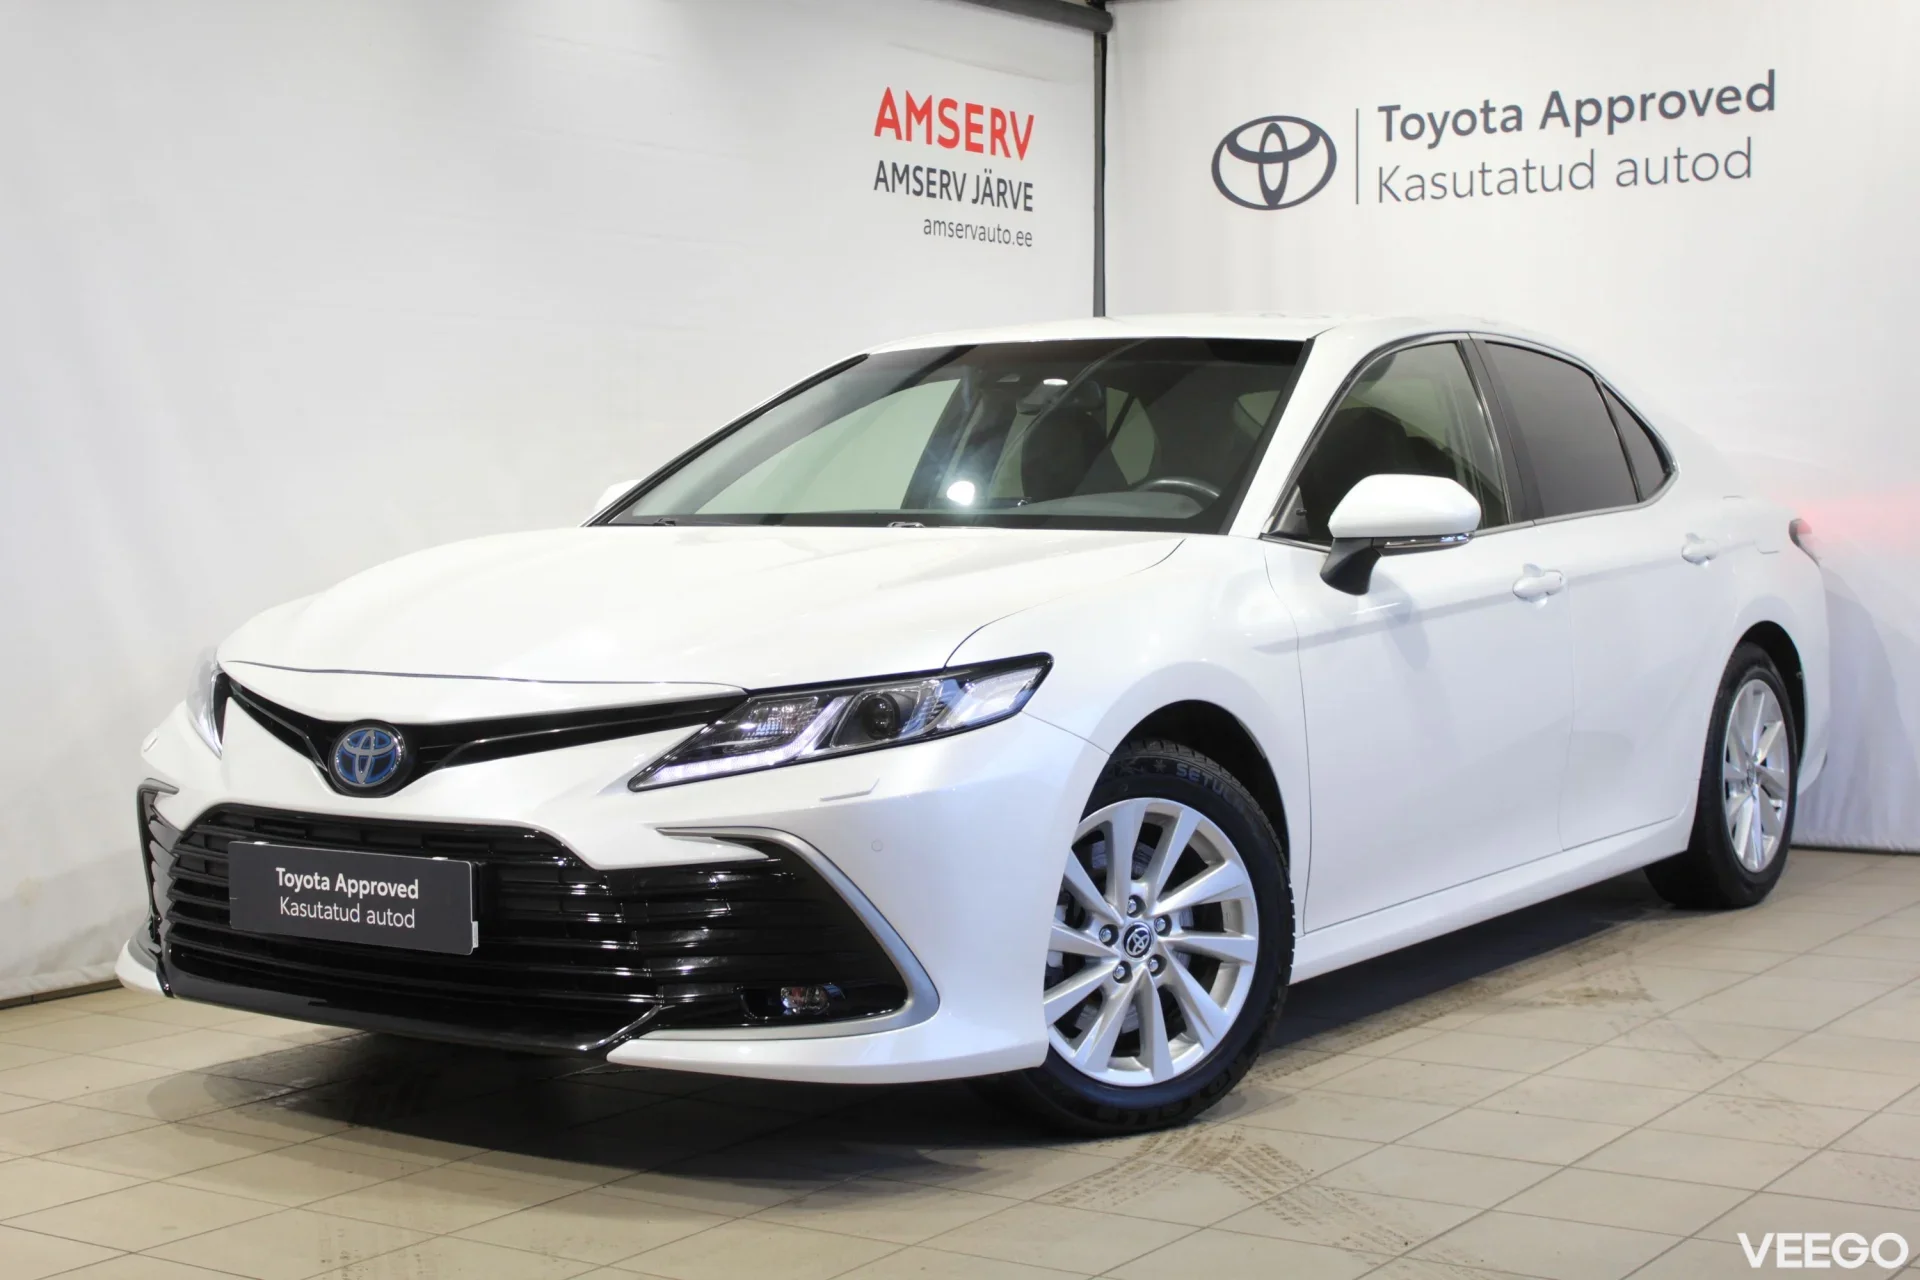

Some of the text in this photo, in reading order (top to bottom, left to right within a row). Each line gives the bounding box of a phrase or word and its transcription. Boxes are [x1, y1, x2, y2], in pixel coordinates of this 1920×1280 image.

[873, 86, 1035, 161] AMSERV
[1377, 68, 1776, 150] Toyota Approved
[873, 160, 1034, 212] AMSERV JÄRVE
[1378, 136, 1752, 204] Kasutatud autod
[923, 218, 1033, 248] amservauto.ee
[275, 866, 419, 900] Toyota Approved
[279, 895, 416, 929] Kasutatud autod
